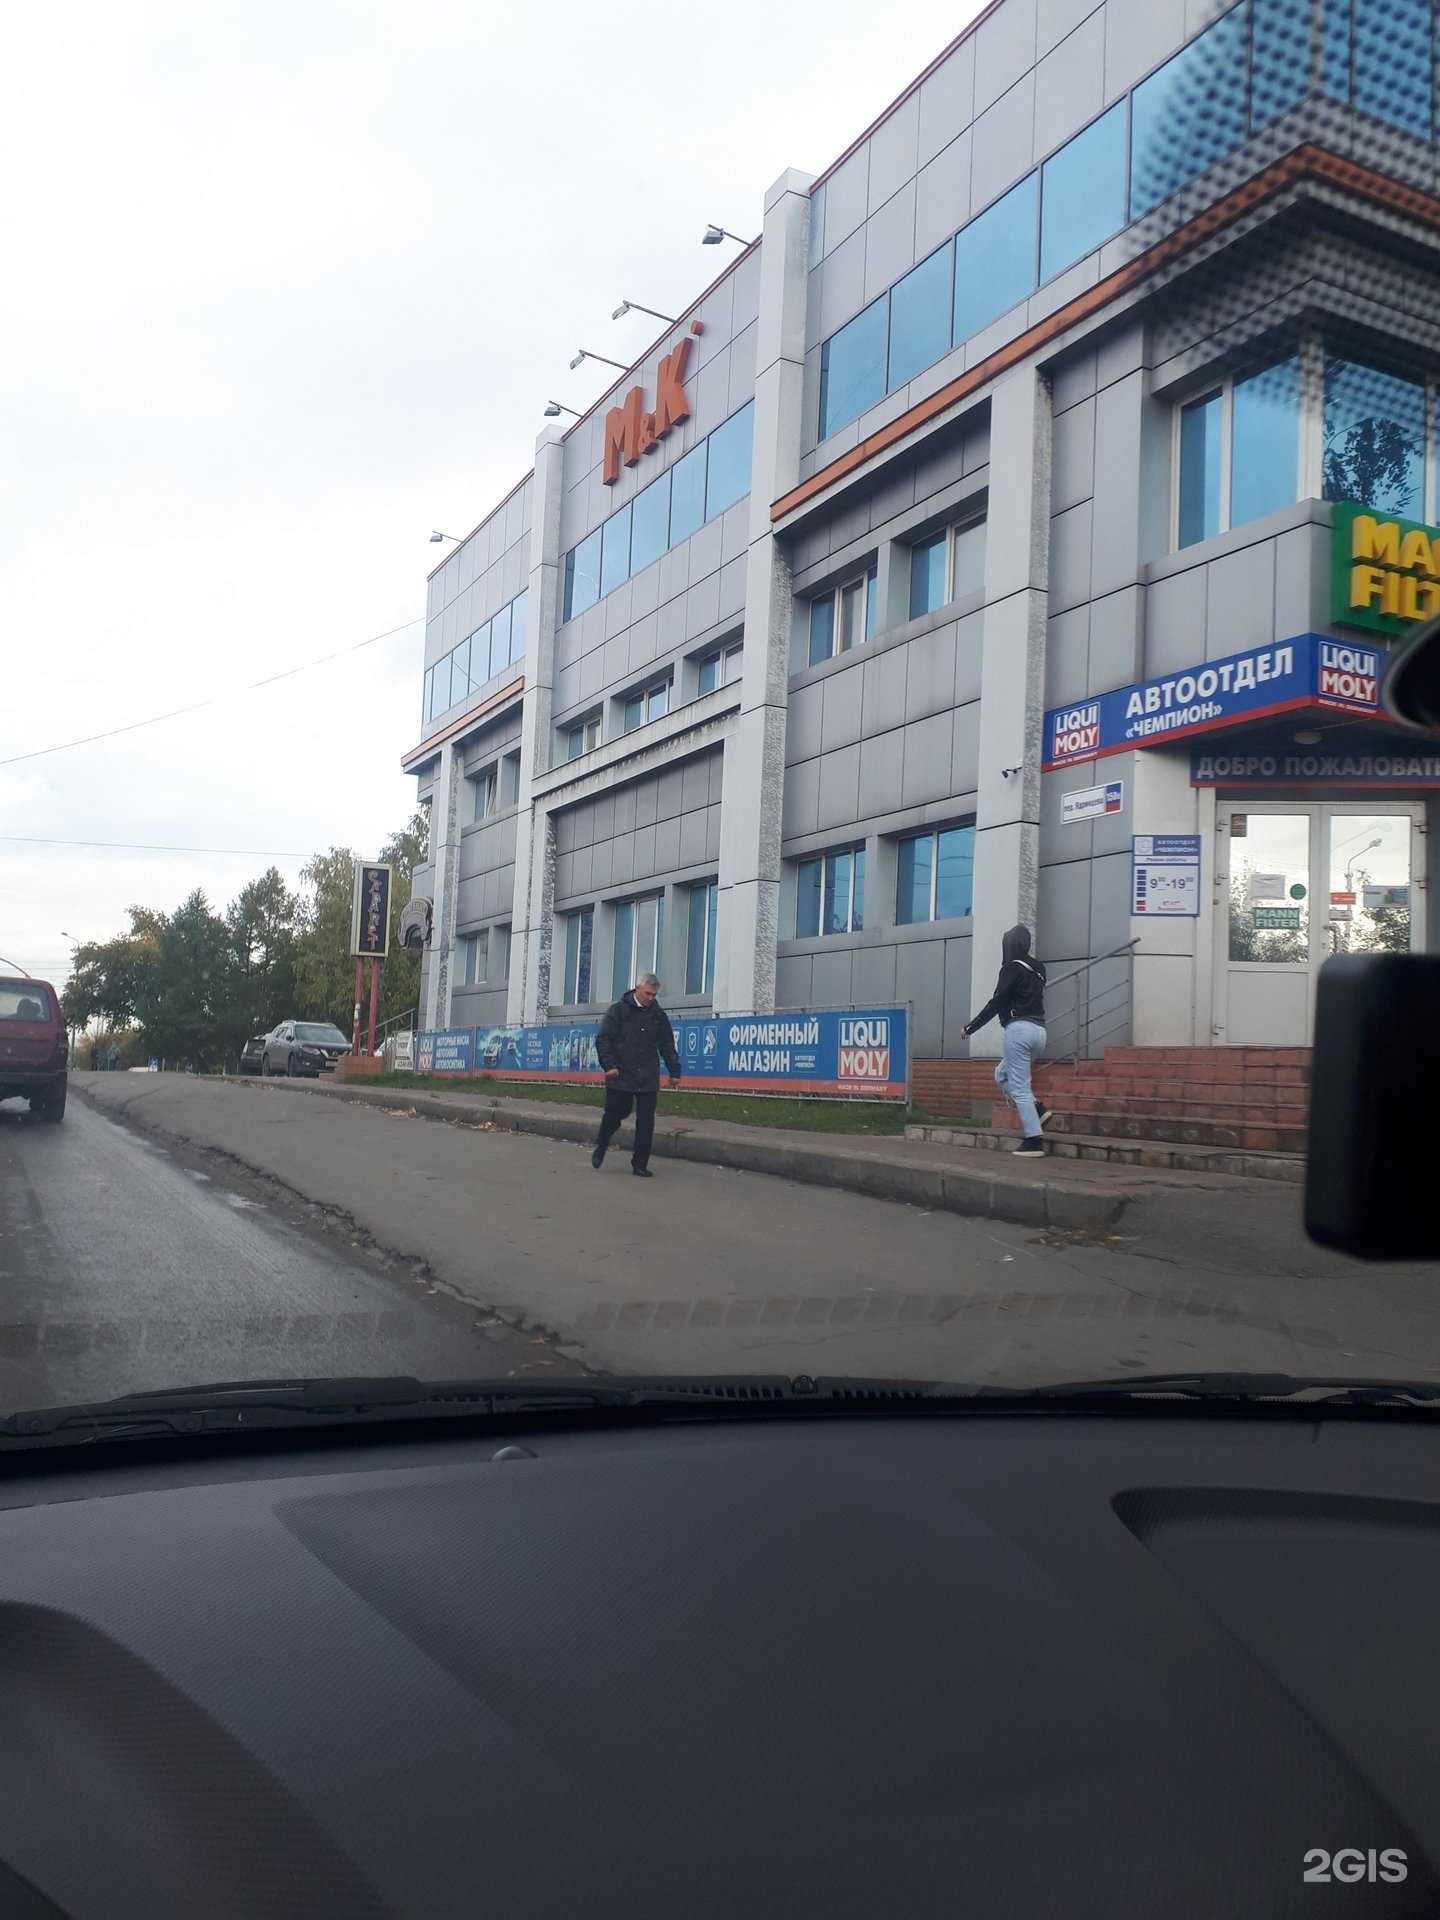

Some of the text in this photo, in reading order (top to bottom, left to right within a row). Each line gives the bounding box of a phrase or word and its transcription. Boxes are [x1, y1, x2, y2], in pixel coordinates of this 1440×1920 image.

[1322, 645, 1376, 676] LIQUI
[1125, 646, 1294, 719] АВТООТДЕЛ
[1321, 670, 1376, 701] MOLY
[1055, 704, 1098, 735] LIQUI
[1125, 701, 1223, 739] «ЧЕМПИОН»
[1054, 727, 1098, 756] MOLY
[1197, 756, 1277, 779] ДОБРО
[1256, 909, 1298, 919] MANN
[1256, 918, 1298, 929] FILTER
[729, 1017, 819, 1046] ФИРМЕННЫЙ
[841, 1020, 887, 1047] LIQUI
[728, 1050, 790, 1073] МАГАЗИН
[840, 1050, 888, 1076] MOLY
